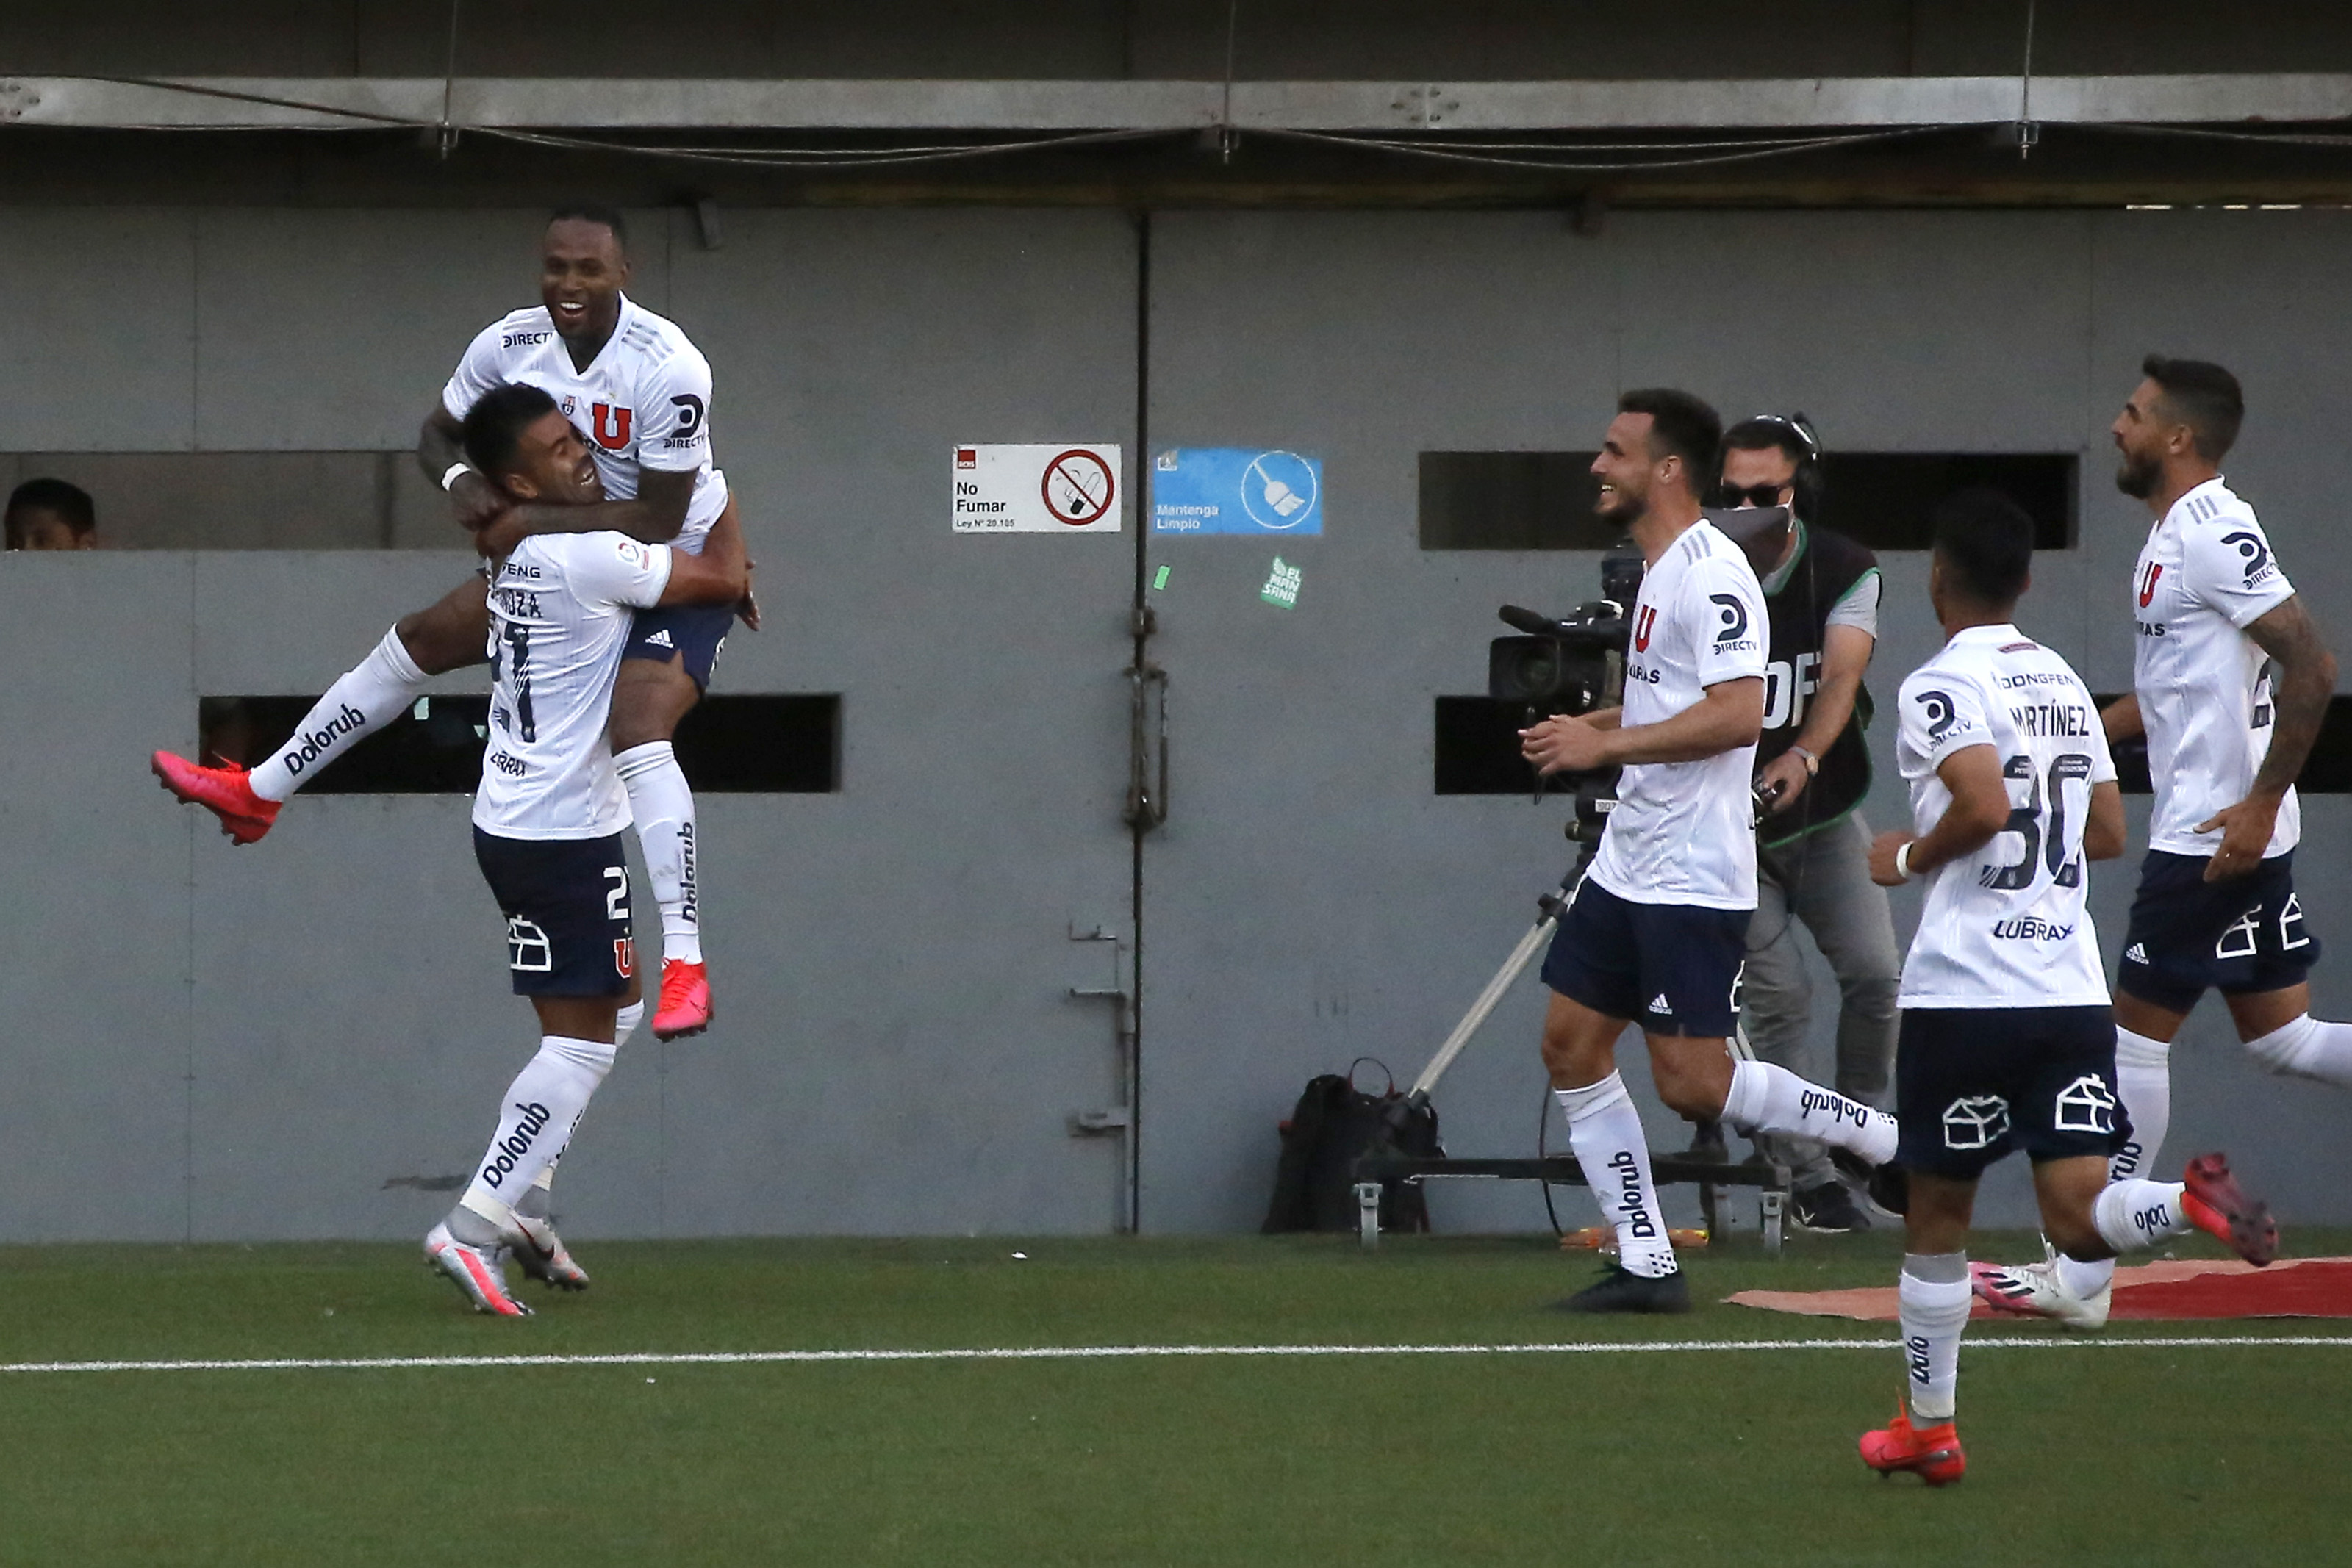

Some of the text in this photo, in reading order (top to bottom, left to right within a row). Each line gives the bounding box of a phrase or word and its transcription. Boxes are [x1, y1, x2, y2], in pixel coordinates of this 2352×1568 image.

[592, 403, 632, 450] U
[957, 482, 978, 495] No
[957, 500, 1006, 512] Fumar
[1157, 505, 1219, 518] Mantenga
[957, 519, 972, 528] Ley
[1157, 518, 1200, 531] Limpio
[1287, 567, 1301, 582] EL
[1261, 583, 1296, 603] SANA
[1635, 604, 1657, 653] U
[1713, 641, 1757, 655] DIRECTV
[2009, 698, 2090, 737] MRTÍNEZ
[284, 703, 366, 777] Dolorub
[1979, 754, 2095, 889] 30
[677, 821, 698, 924] Dolorub
[1993, 916, 2074, 941] LUBRAX
[1801, 1089, 1868, 1129] Dolorub
[482, 1101, 550, 1190] Dolorub
[1607, 1150, 1656, 1239] Dolorub
